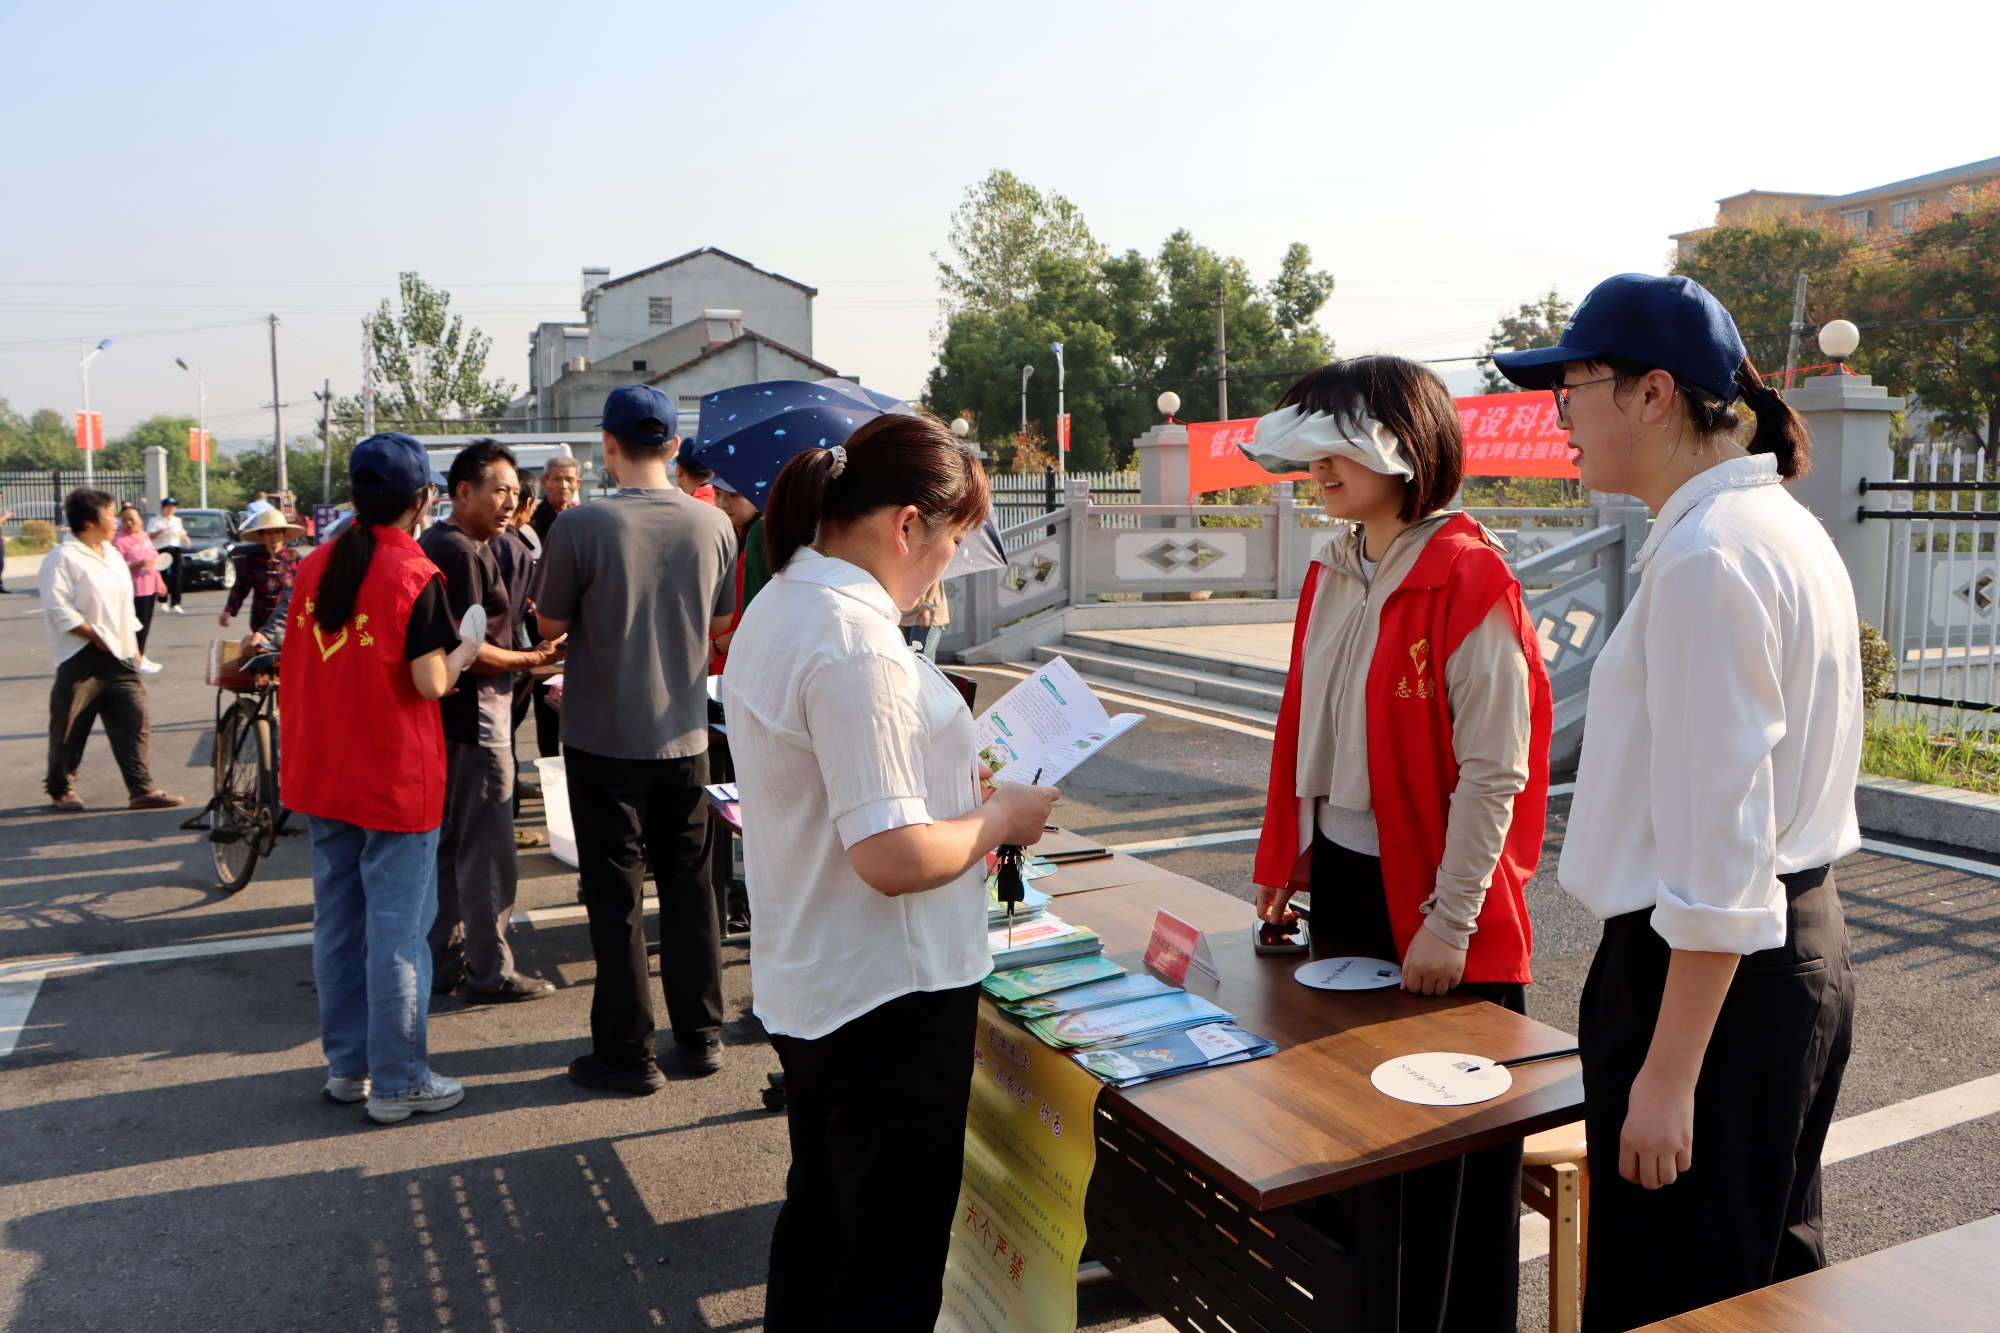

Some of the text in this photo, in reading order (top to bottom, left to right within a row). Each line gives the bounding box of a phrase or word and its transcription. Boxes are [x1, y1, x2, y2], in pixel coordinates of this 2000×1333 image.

[1210, 426, 1255, 459] 提升
[1395, 675, 1436, 699] 志愿者
[988, 1023, 1030, 1074] 坚决制止
[965, 1203, 1024, 1284] 六个严禁
